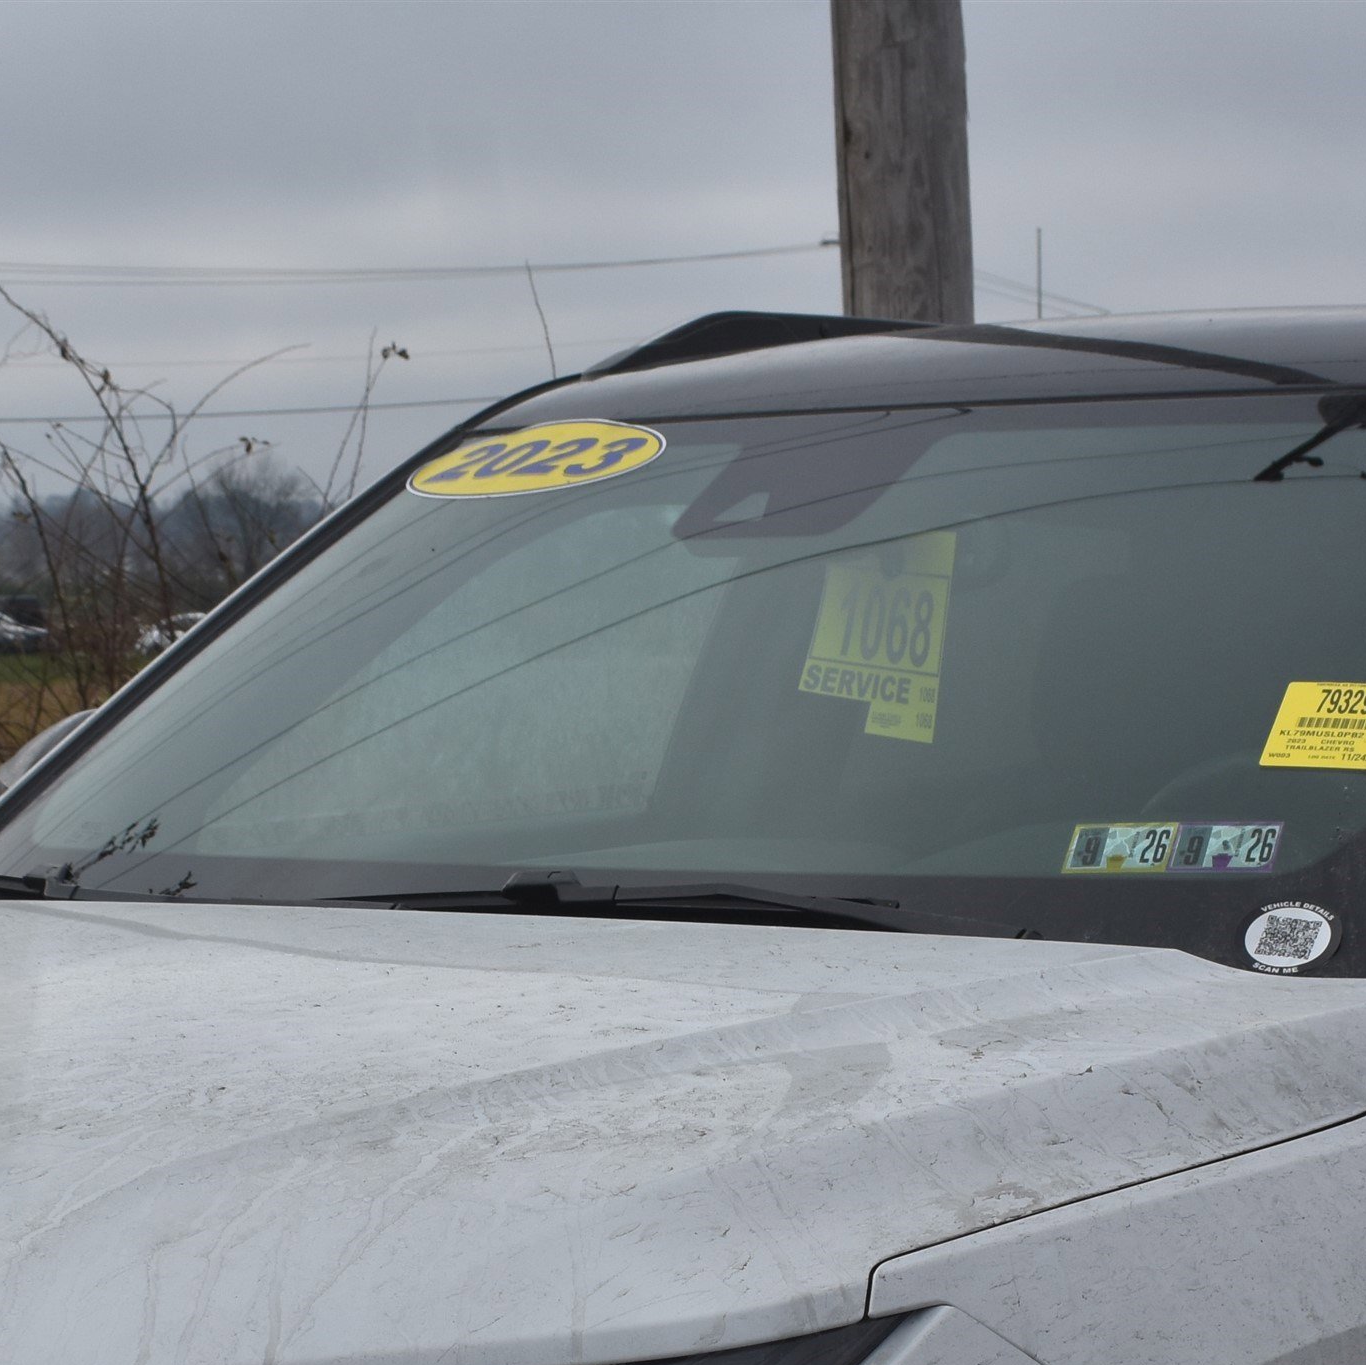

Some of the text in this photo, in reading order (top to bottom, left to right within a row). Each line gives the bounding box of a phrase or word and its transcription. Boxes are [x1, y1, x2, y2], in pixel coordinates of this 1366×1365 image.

[422, 436, 649, 484] 2023
[838, 583, 934, 669] 1068
[801, 663, 913, 706] SERVICE
[1138, 829, 1171, 864] 26
[1244, 827, 1278, 863] 26
[1260, 900, 1336, 921] VEHICLE DETAILS
[1252, 961, 1299, 974] SCAN ME
